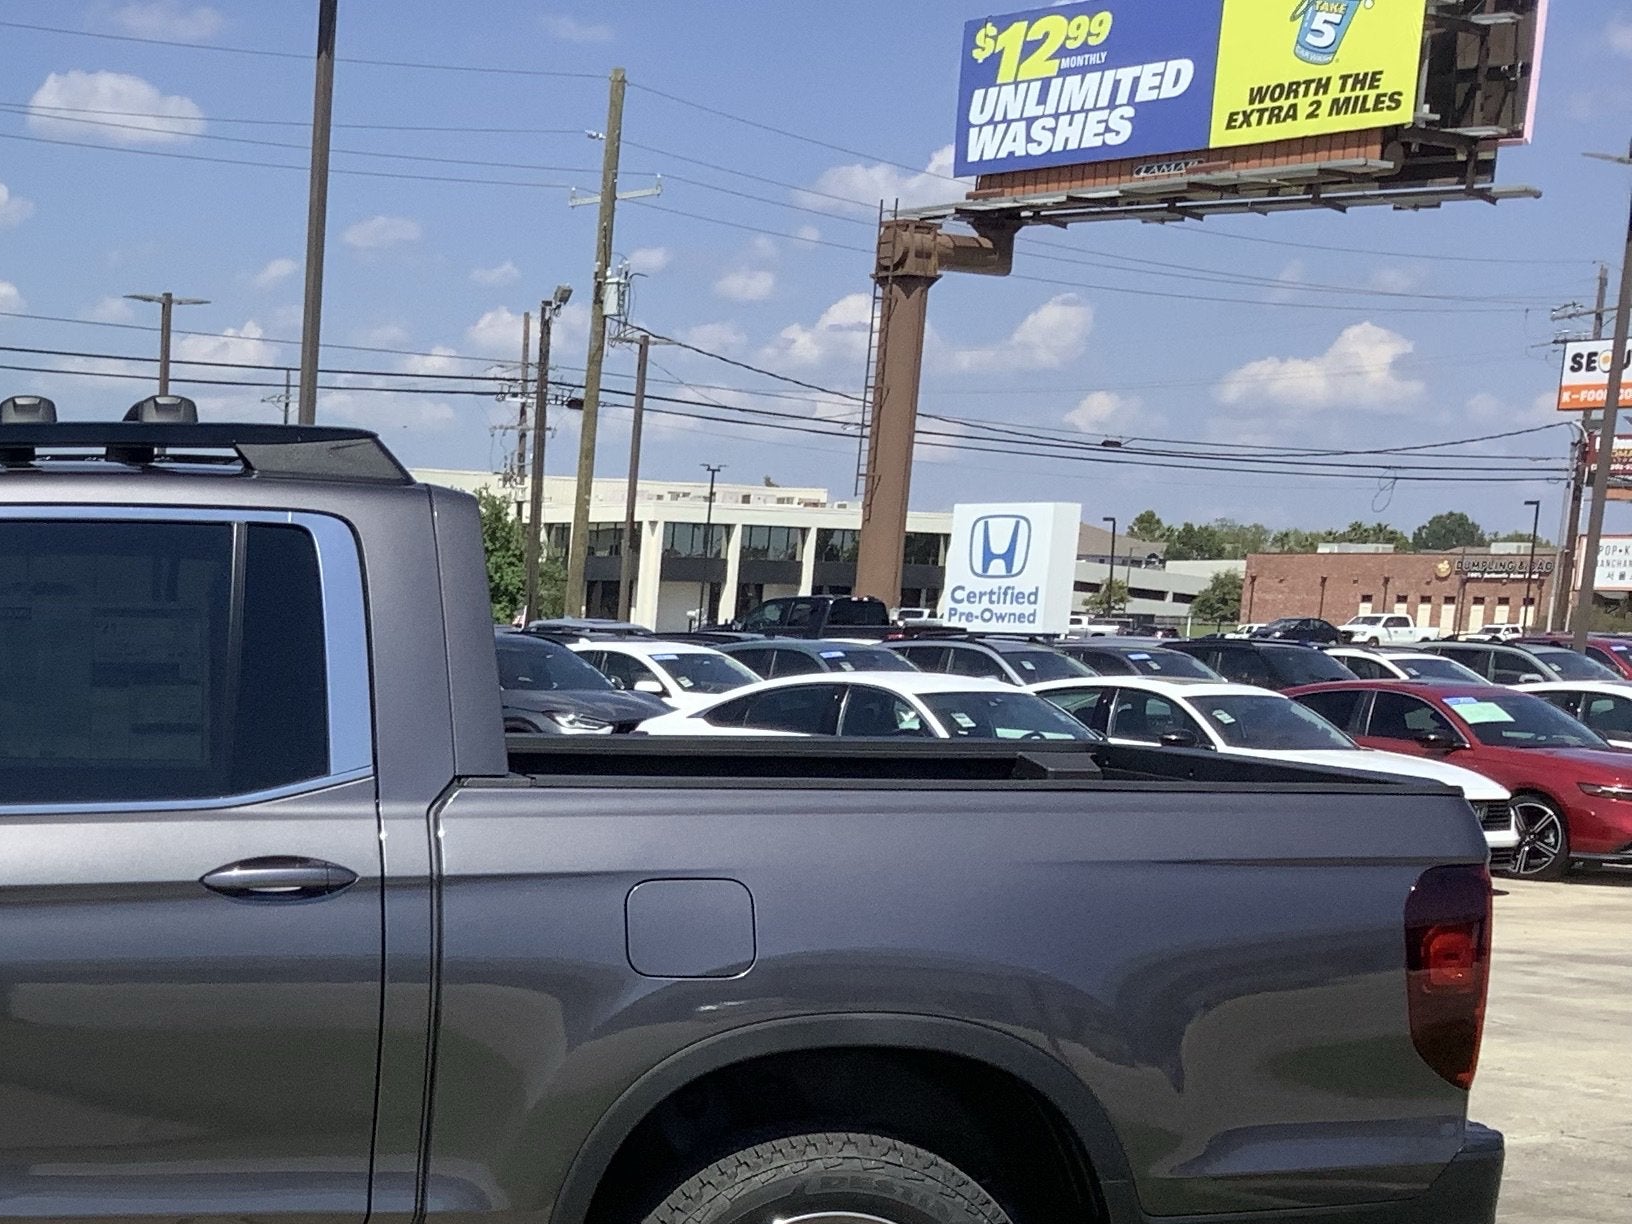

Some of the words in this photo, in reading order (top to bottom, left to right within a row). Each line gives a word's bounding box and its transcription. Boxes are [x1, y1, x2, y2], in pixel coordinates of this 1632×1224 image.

[1305, 11, 1344, 49] 5
[1060, 51, 1108, 69] MONTHLY
[968, 58, 1195, 125] UNLIMITED
[1248, 76, 1332, 105] WORTH
[1339, 70, 1383, 93] THE
[1225, 103, 1299, 130] EXTRA
[1305, 100, 1322, 120] 2
[1328, 91, 1403, 117] MILES
[967, 106, 1136, 163] WASHES
[1561, 388, 1608, 403] K-FOO
[1455, 560, 1515, 572] DUMPLING
[950, 585, 1039, 606] Certified
[948, 607, 1037, 625] Pre-Owned
